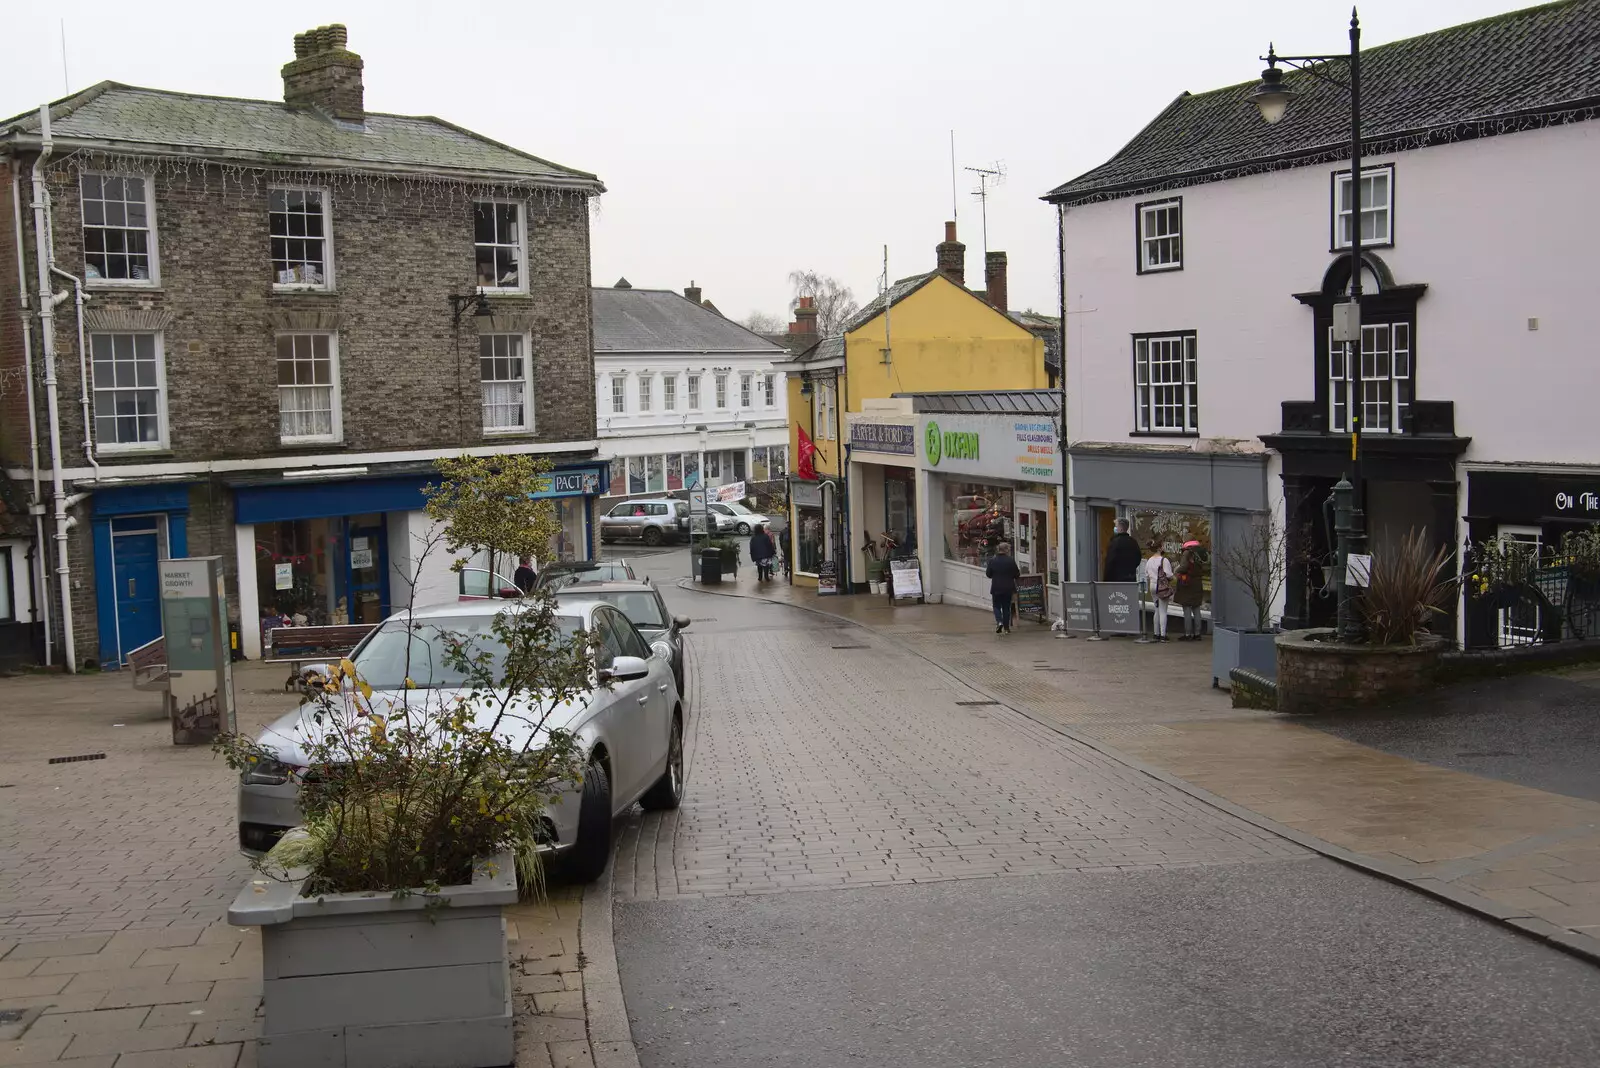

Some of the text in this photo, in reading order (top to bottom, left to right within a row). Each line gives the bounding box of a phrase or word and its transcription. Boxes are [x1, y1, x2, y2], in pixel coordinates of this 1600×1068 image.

[878, 427, 884, 441] &
[885, 427, 903, 443] FORD
[944, 431, 980, 461] OXFAM
[556, 475, 581, 490] PACT
[1108, 604, 1130, 614] BAKEHOUSE
